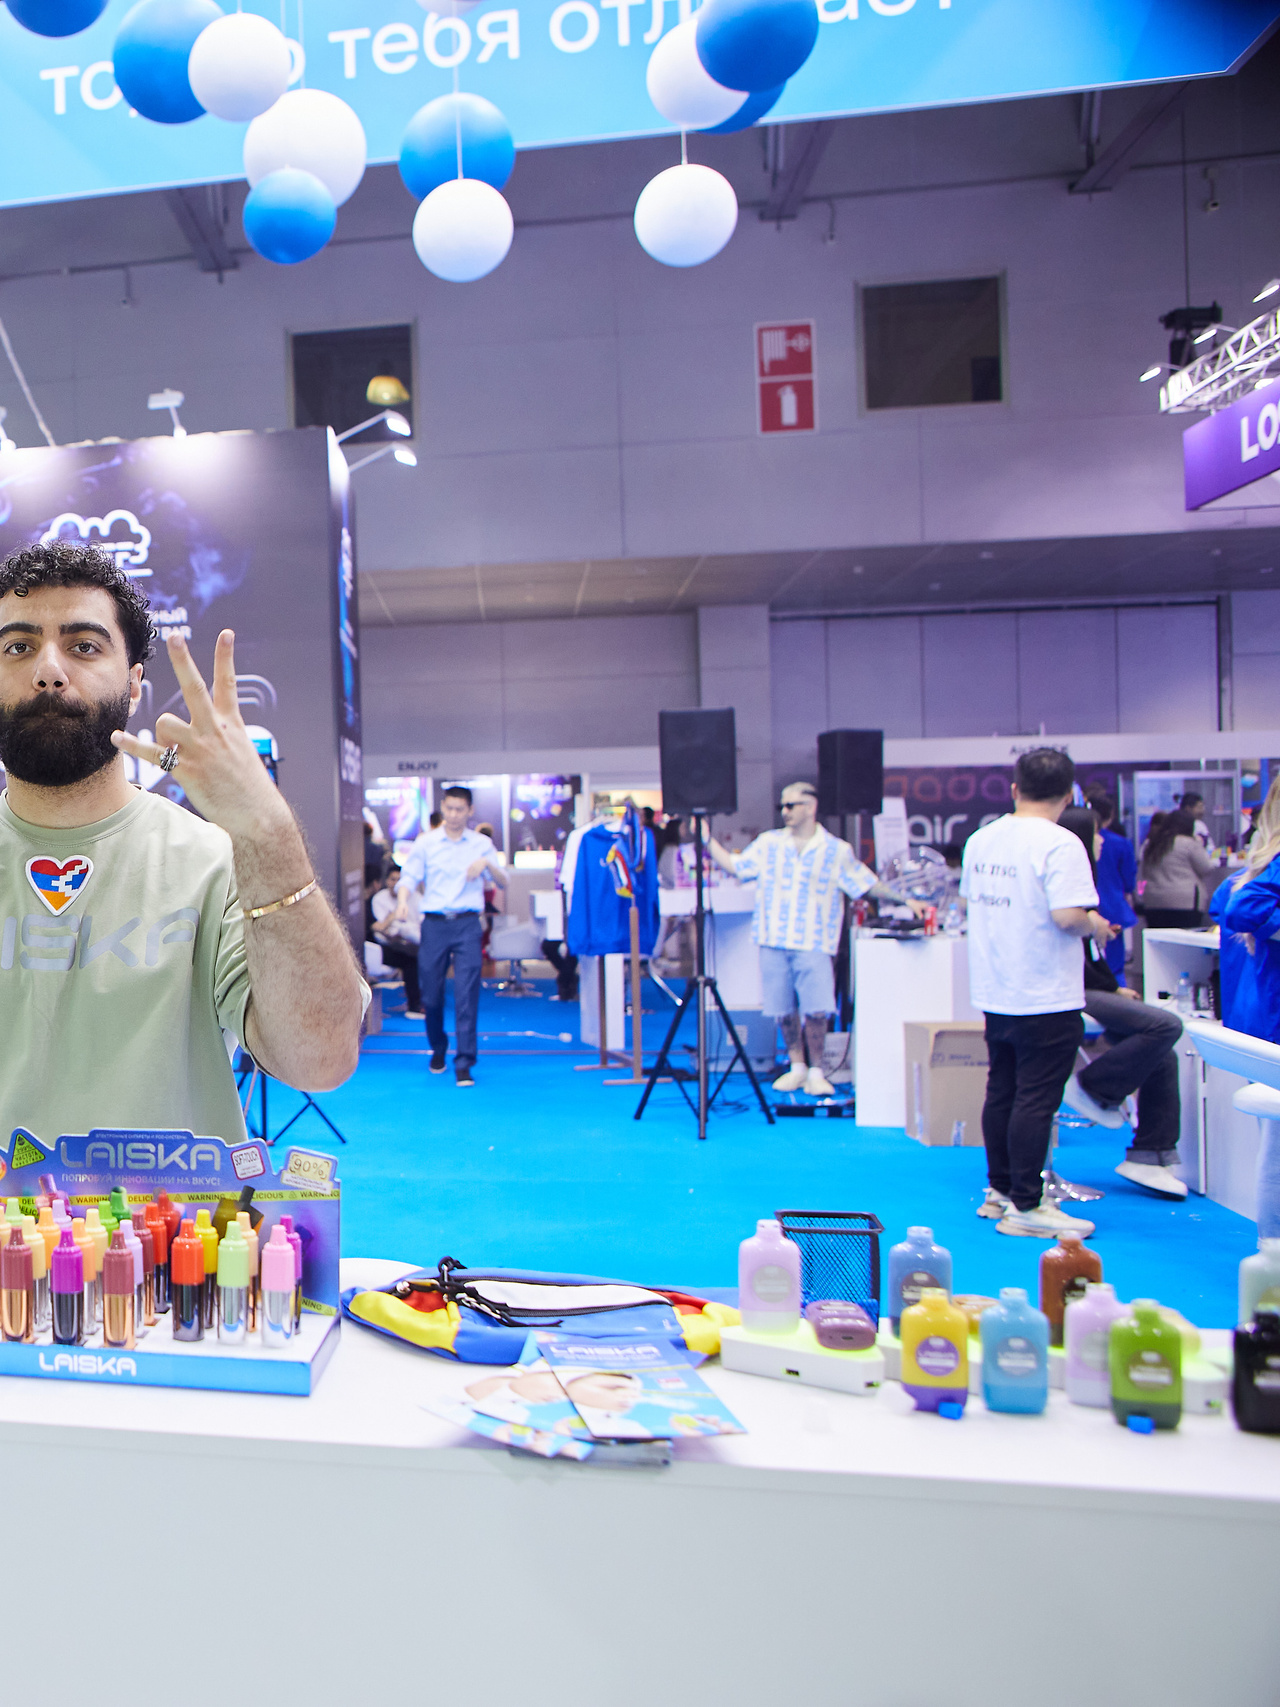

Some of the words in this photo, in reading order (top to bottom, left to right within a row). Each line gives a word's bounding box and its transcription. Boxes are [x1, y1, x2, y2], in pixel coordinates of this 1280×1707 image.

[328, 10, 520, 79] тебя
[1240, 397, 1280, 463] LO
[397, 760, 439, 772] ENJOY
[907, 814, 968, 845] air
[60, 1141, 221, 1171] LAISKA
[293, 1157, 325, 1176] 90%
[61, 1172, 113, 1184] ПОПРОБУЙ
[114, 1175, 175, 1185] ИННОВАЦИИ
[177, 1177, 190, 1185] НА
[192, 1177, 221, 1186] ВКУС!
[38, 1352, 137, 1377] LAISKA
